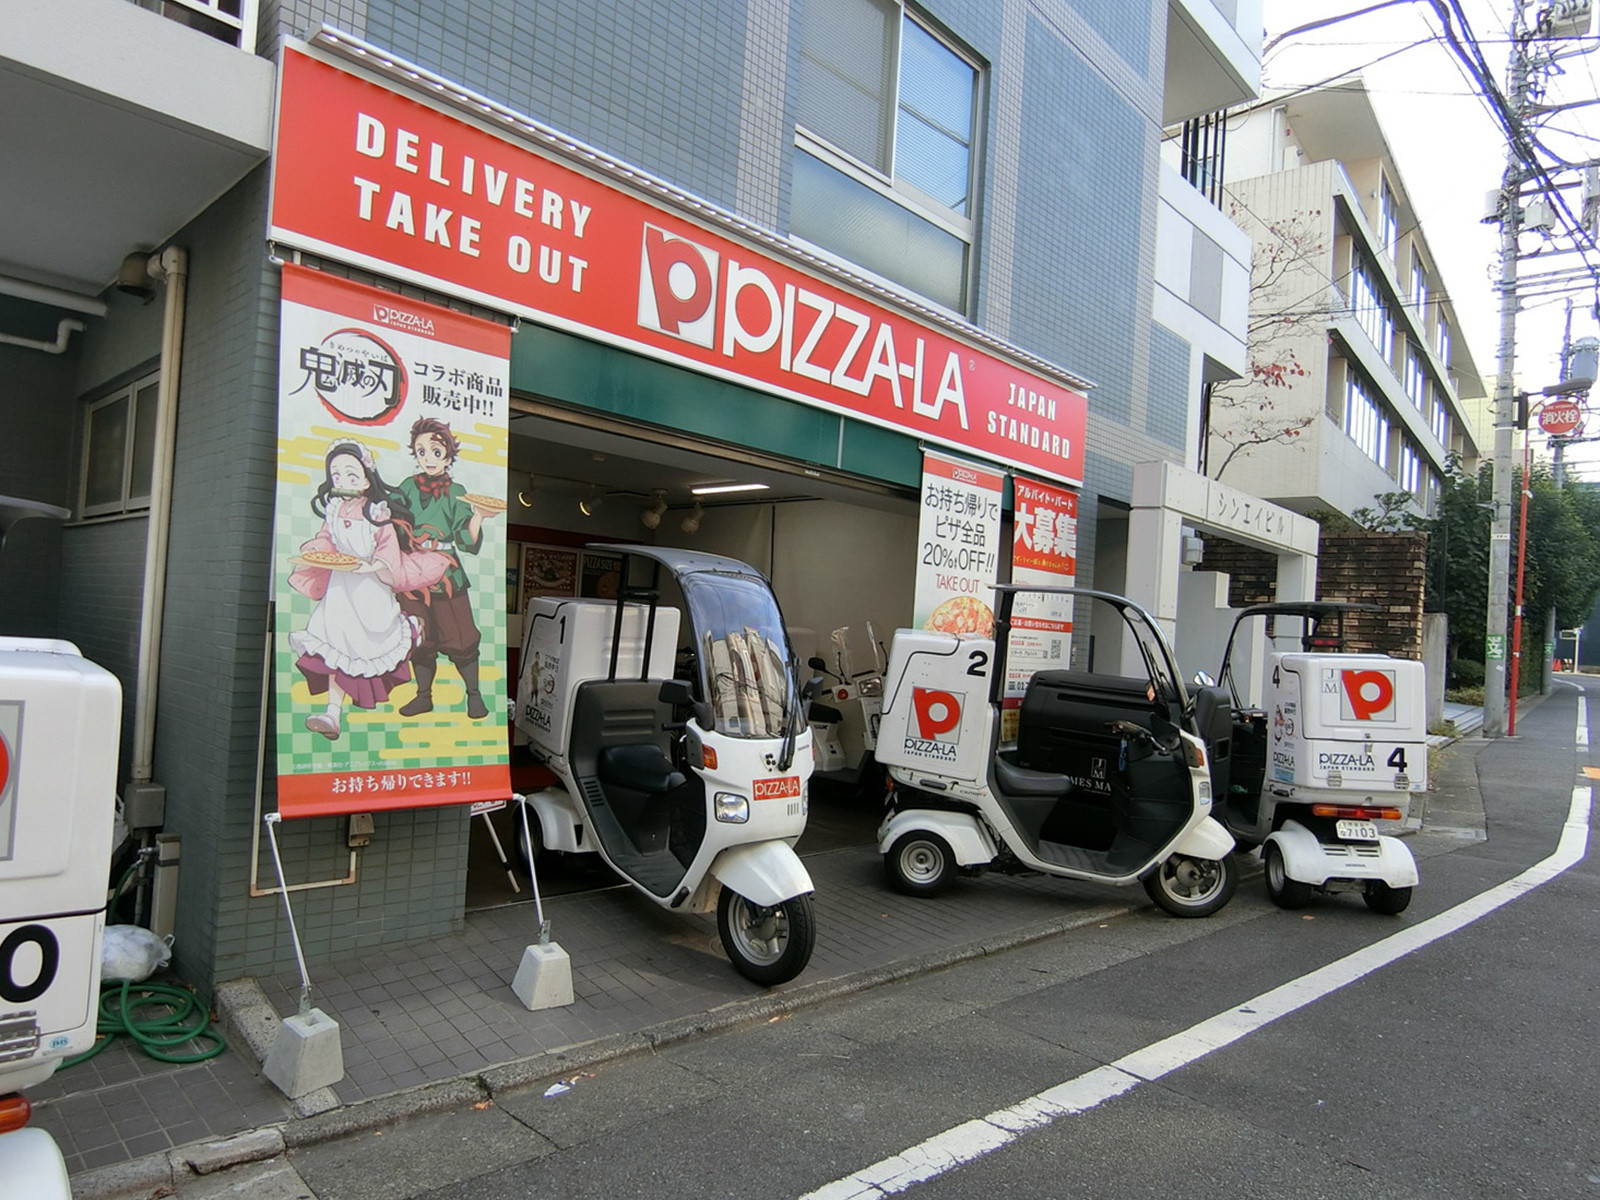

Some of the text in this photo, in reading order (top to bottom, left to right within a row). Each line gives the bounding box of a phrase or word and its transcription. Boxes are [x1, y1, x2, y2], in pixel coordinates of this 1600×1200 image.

[355, 112, 592, 239] DELIVERY
[353, 176, 588, 293] TAKE OUT
[390, 308, 435, 331] PIZZA-LA
[722, 259, 969, 430] PIZZA-LA
[288, 346, 400, 407] 鬼滅の刃
[414, 361, 503, 397] コラボ商品
[422, 384, 494, 417] 販売中!!
[1008, 382, 1056, 421] JAPAN
[1542, 410, 1578, 425] 消火栓
[987, 410, 1070, 459] STANDARD
[925, 483, 998, 521] お持ち帰りで
[1219, 493, 1284, 535] シンエイビル
[935, 515, 986, 547] ピザ全品
[1014, 503, 1077, 559] 大募集
[936, 573, 980, 594] TAKE OUT
[559, 616, 566, 644] 1
[967, 650, 989, 677] 2
[1272, 665, 1280, 688] 4
[904, 738, 957, 757] PIZZA-LA
[1319, 753, 1375, 767] PIZZA-LA
[1387, 747, 1407, 773] 4
[331, 771, 472, 794] お持ち帰りできます!!
[755, 780, 799, 796] PIZZA-LA
[1070, 776, 1092, 788] MES
[1347, 828, 1375, 838] 7103
